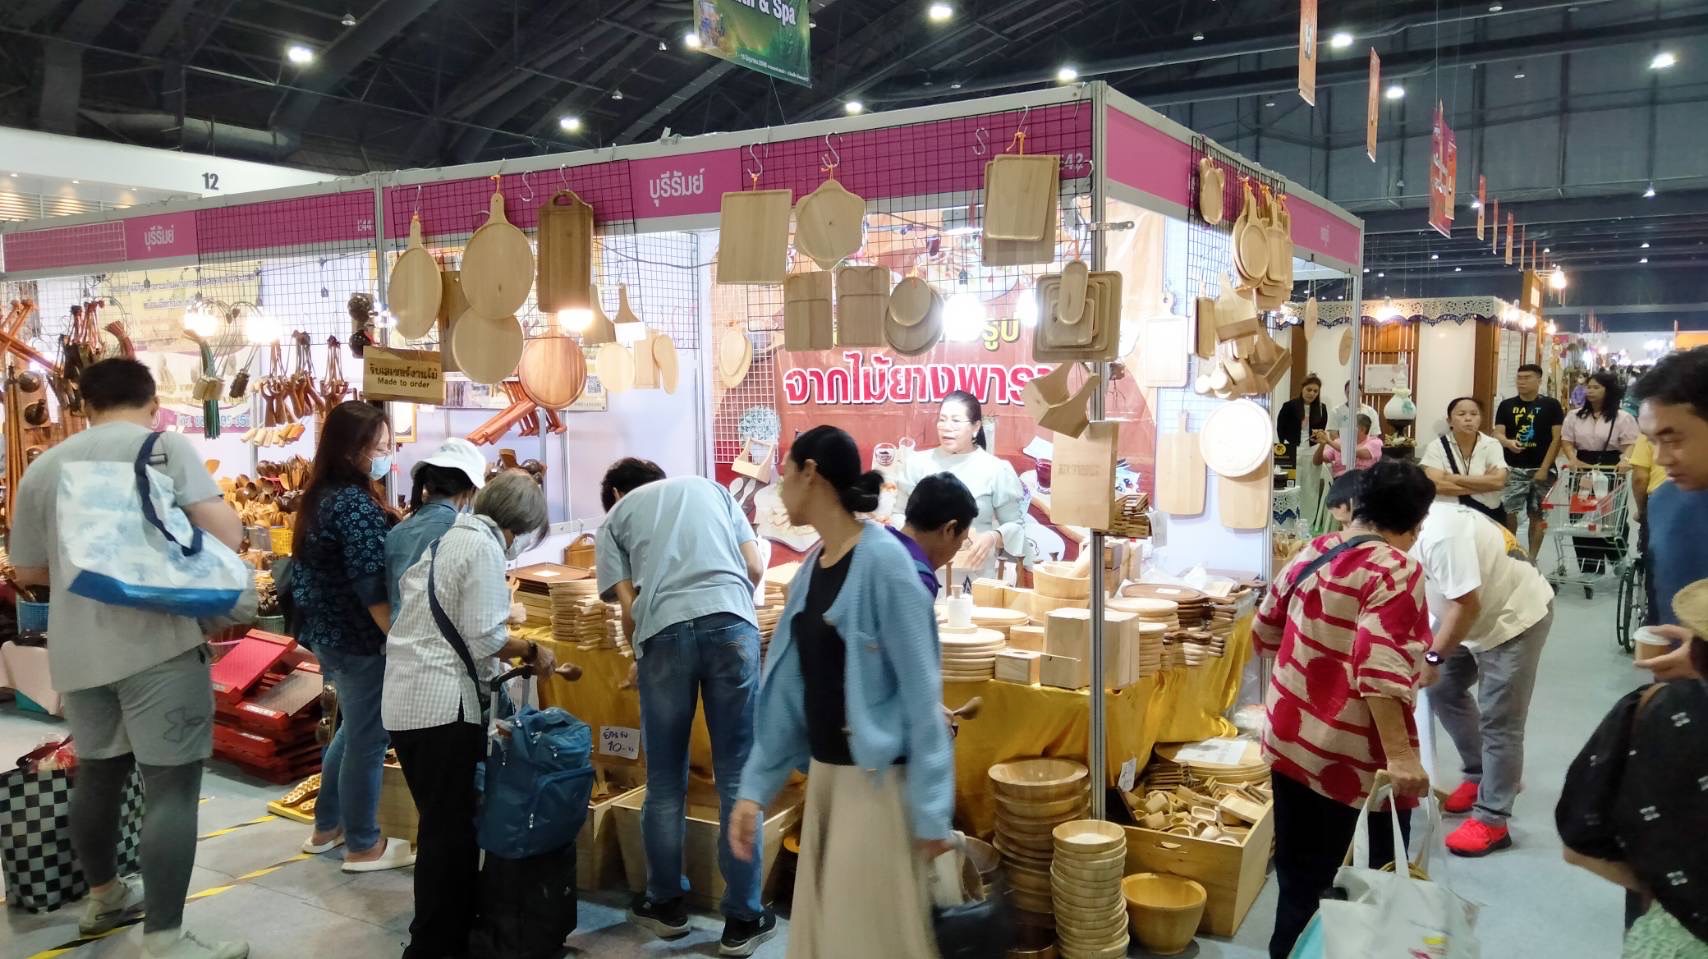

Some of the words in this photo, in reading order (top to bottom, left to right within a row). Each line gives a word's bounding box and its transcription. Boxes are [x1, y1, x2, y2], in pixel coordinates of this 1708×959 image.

[758, 0, 770, 14] &
[772, 0, 796, 26] Spa
[201, 172, 219, 190] 12
[649, 168, 705, 207] บุรีรัมย์
[377, 377, 397, 386] Made
[400, 379, 407, 387] to
[410, 381, 430, 389] order
